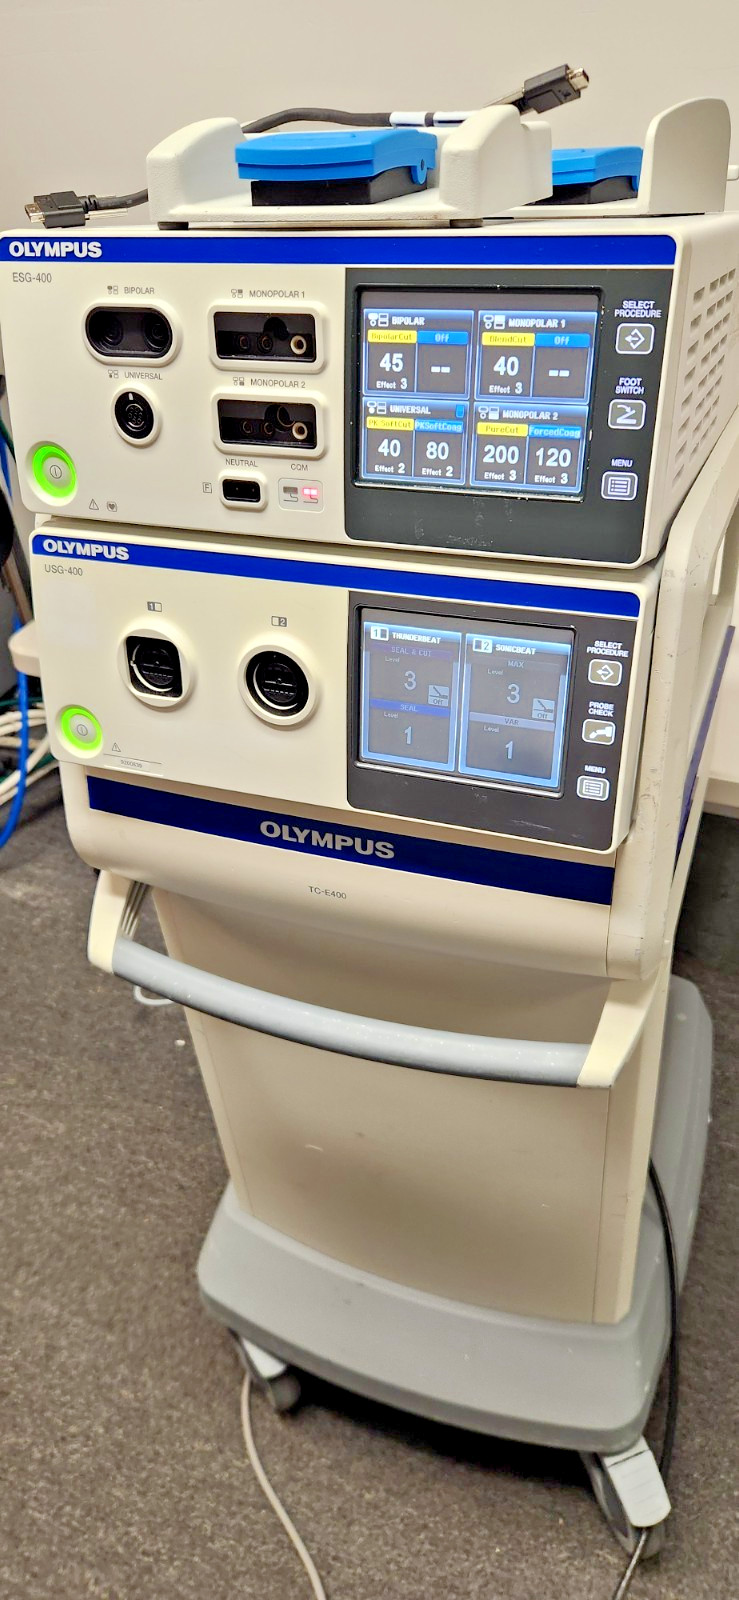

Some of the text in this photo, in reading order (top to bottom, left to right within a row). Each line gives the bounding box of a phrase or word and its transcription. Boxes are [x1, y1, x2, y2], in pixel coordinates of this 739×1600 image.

[9, 241, 102, 258] OLYMPUS
[12, 272, 52, 283] ESG-400
[124, 286, 155, 294] BIPOLAR
[249, 290, 298, 298] MONOPOLAR
[622, 300, 655, 309] SELECT
[614, 309, 662, 318] PROCEDURE
[391, 316, 425, 325] BIPOLAR
[508, 318, 566, 328] MONOPOLAR 1
[371, 333, 412, 341] BipolarCut
[435, 333, 449, 342] Off
[554, 336, 569, 345] Off
[379, 352, 404, 372] 45
[493, 356, 519, 376] 40
[124, 371, 163, 380] UNIVERSAL
[250, 378, 299, 388] MONOPOLAR
[376, 377, 408, 389] Effect 3
[619, 377, 642, 386] FOOT
[489, 382, 523, 394] Effect 3
[615, 385, 645, 395] SWITCH
[389, 404, 431, 414] UNIVERSAL
[502, 410, 559, 420] MONOPOLAR 2
[485, 425, 519, 433] PureCut
[529, 426, 581, 438] ForcedCoag
[378, 438, 401, 457] 40
[426, 441, 449, 460] 80
[482, 444, 519, 464] 200
[535, 447, 571, 467] 120
[225, 459, 258, 467] NEUTRAL
[374, 462, 405, 473] Effect 2
[611, 459, 633, 467] MENU
[421, 466, 453, 477] Effect 2
[484, 469, 517, 481] Effect 3
[534, 472, 568, 484] Effect 3
[43, 539, 129, 560] OLYMPUS
[44, 564, 83, 576] USG-400
[392, 631, 441, 644] THUNDERBEAT
[495, 644, 536, 655] SONICBEAT
[594, 640, 622, 649] SELECT
[391, 646, 409, 654] SEAL
[586, 647, 629, 657] PROCEDURE
[507, 660, 525, 668] MAX
[487, 668, 503, 676] Level
[404, 670, 417, 690] 3
[507, 683, 520, 704] 3
[400, 704, 418, 712] SEAL
[589, 701, 614, 710] PROBE
[588, 708, 614, 717] CHECK
[504, 718, 520, 726] VAR
[483, 725, 500, 733] Level
[404, 726, 412, 745] 1
[505, 740, 513, 760] 1
[584, 765, 606, 774] MENU
[260, 820, 395, 859] OLYMPUS
[308, 885, 347, 899] TC-E400
